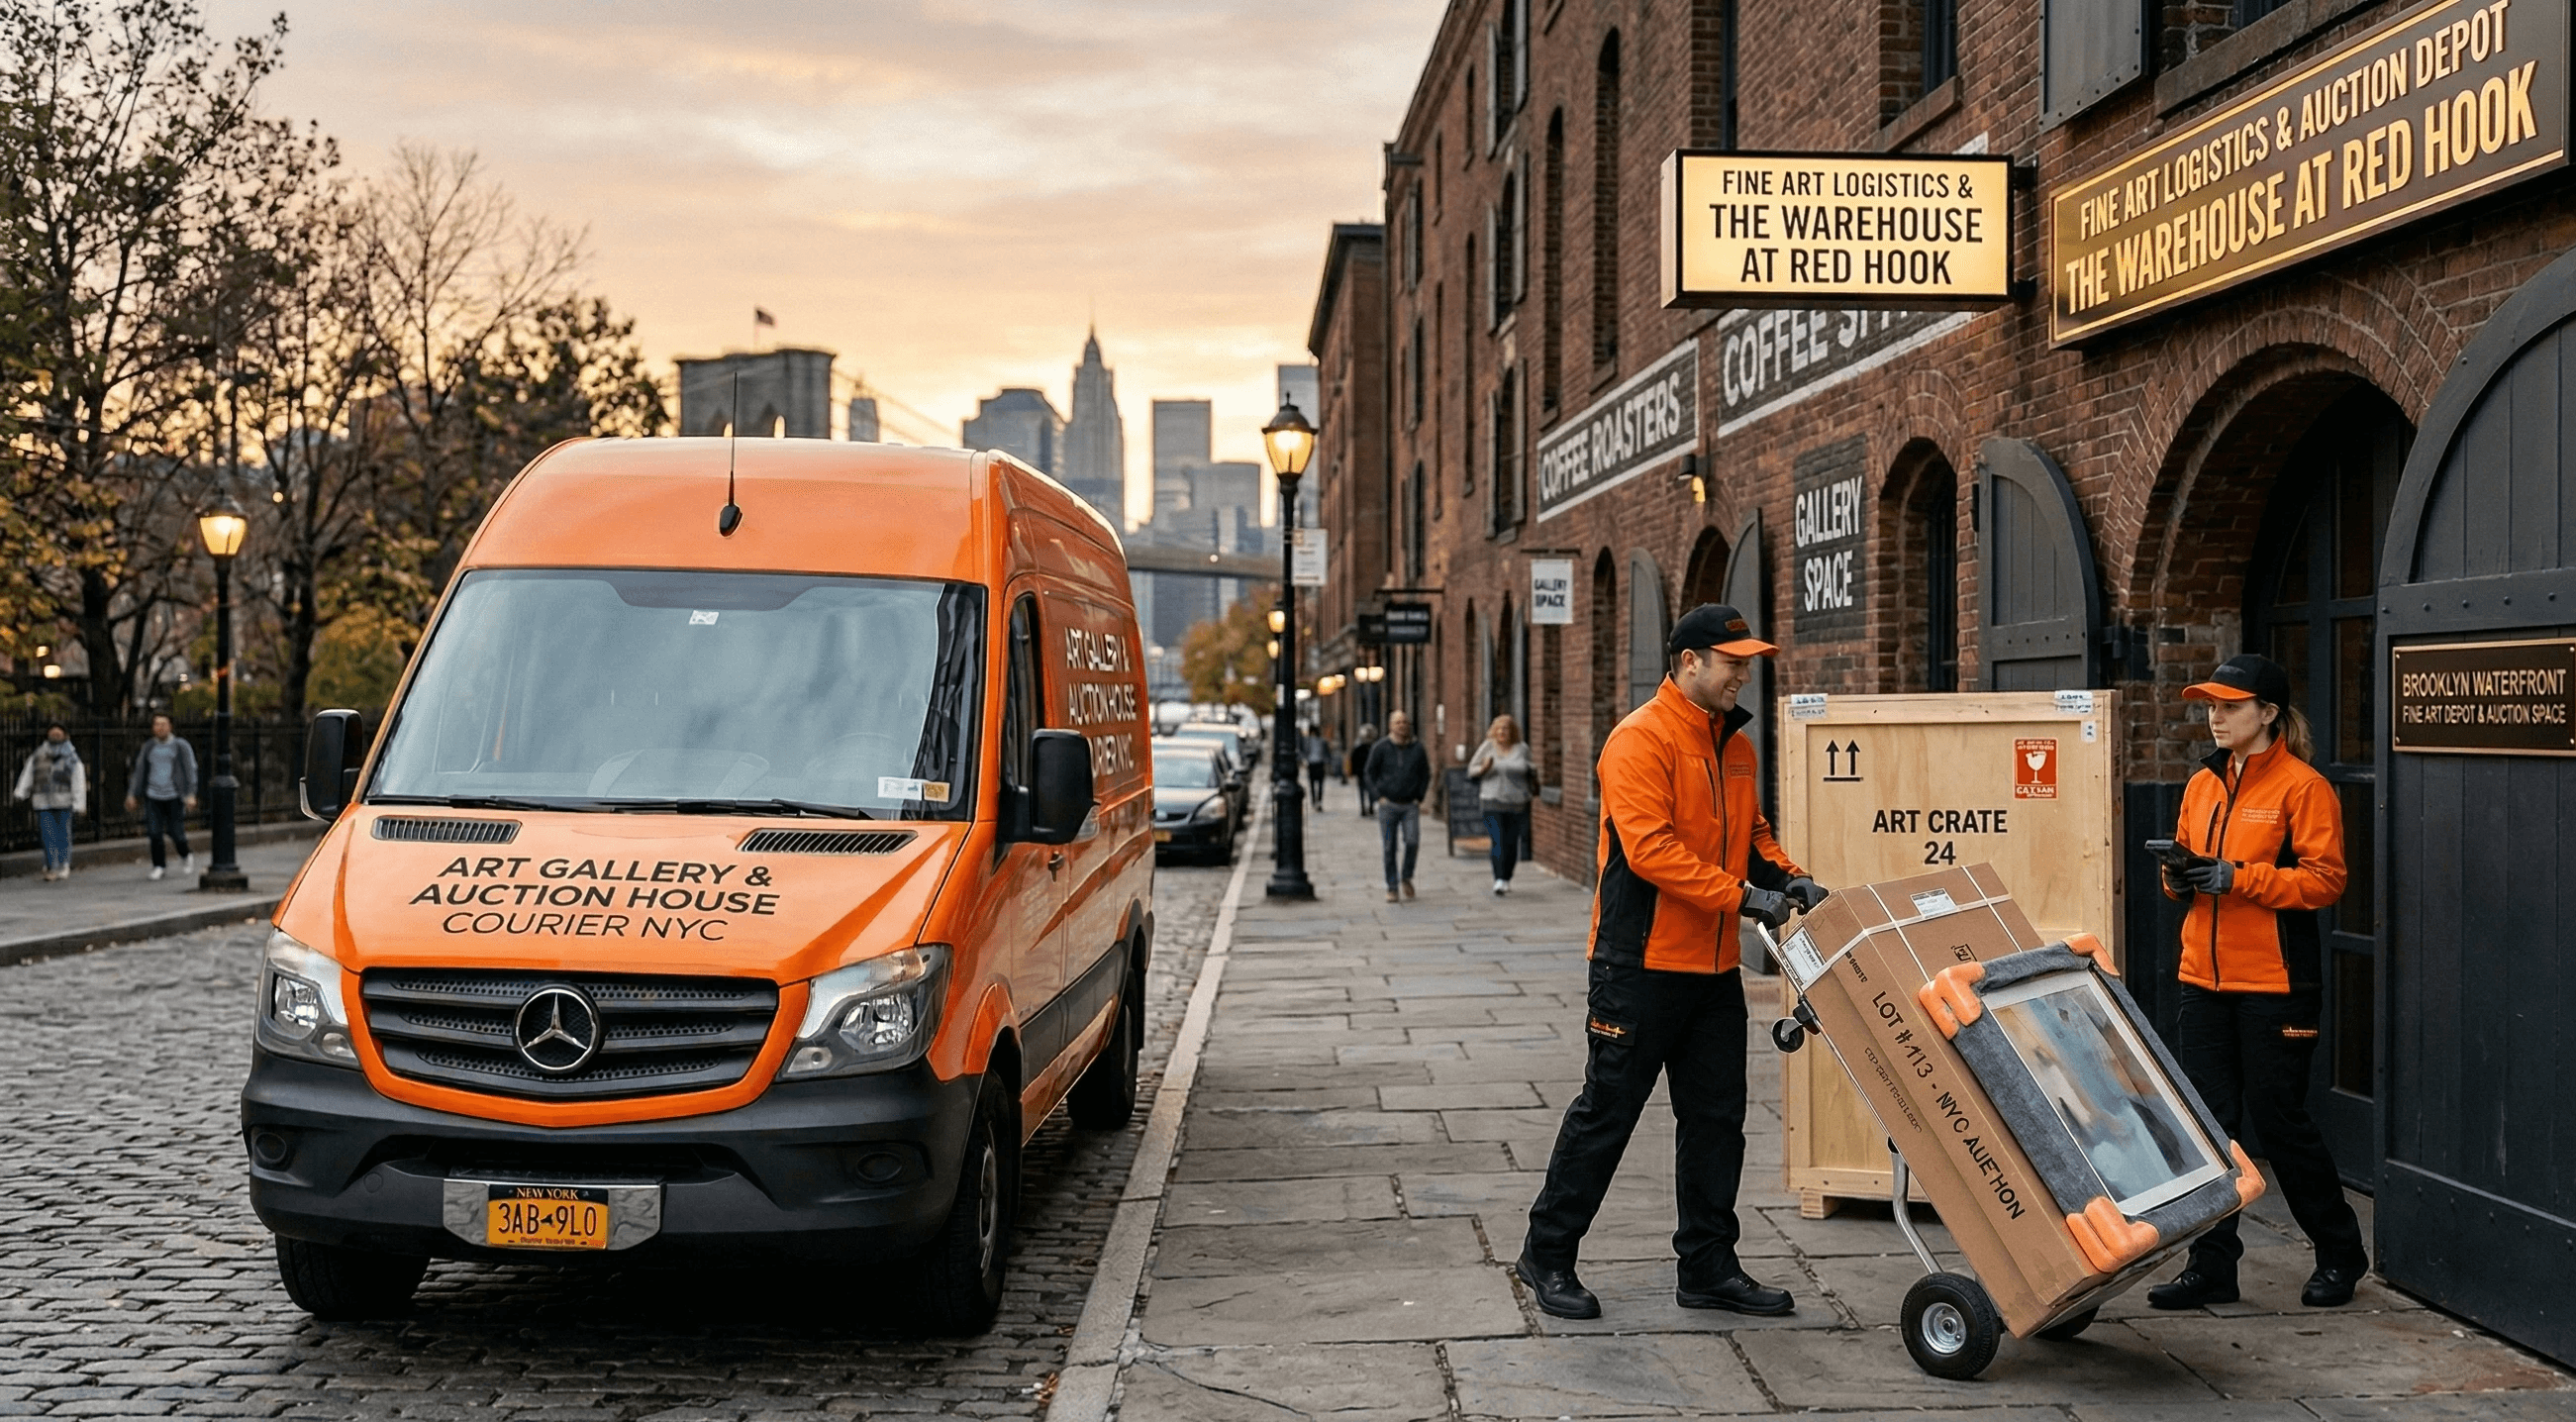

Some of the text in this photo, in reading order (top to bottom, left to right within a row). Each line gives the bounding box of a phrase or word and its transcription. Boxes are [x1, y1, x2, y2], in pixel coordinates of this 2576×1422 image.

[2081, 0, 2510, 242] FINE ART LOGISTICS & AUCTION DEPOT
[1723, 169, 1973, 198] FINE ART LOGISTICS &
[2065, 59, 2537, 315] THE WAREHOUSE AT RED HOOK
[1709, 203, 1983, 244] THE WAREHOUSE
[1740, 248, 1952, 285] AT RED HOOK
[1723, 310, 1829, 407] COFFEE
[1541, 371, 1681, 502] COFFEE ROASTERS
[1795, 475, 1863, 548] GALLERY
[1804, 550, 1853, 612] SPACE
[2403, 668, 2567, 697] BROOKLYN WATERFRONT
[2403, 703, 2566, 724] FINE ART DEPOT & AUCTION SPACE
[1872, 810, 2008, 834] ART CRATE
[1924, 841, 1956, 865] 24
[437, 857, 773, 887] ART GALLERY &
[408, 883, 780, 915] AUCTION HOUSE
[442, 912, 729, 941] COURIER NYC
[1872, 990, 1905, 1028] LOT
[1935, 1091, 1970, 1133] NYC
[517, 1187, 578, 1200] NEW YORK
